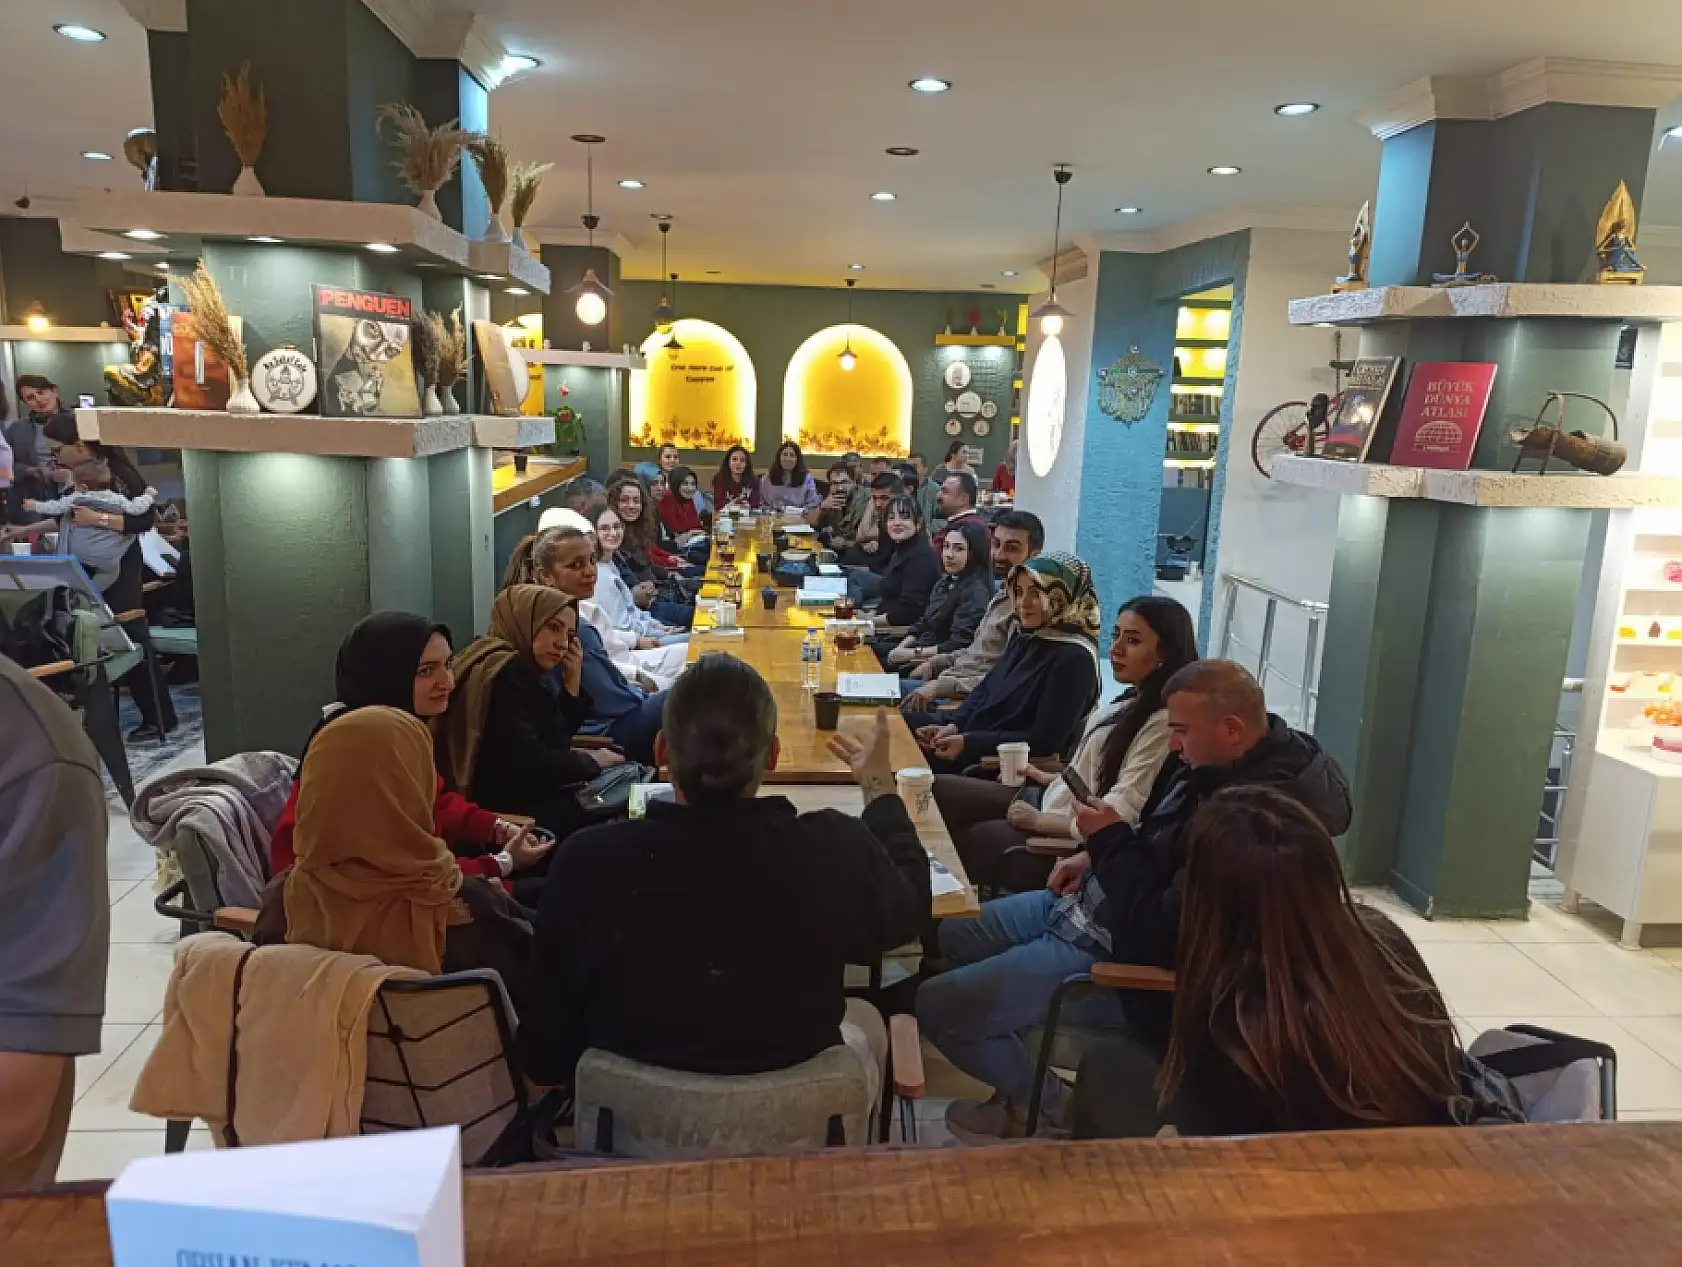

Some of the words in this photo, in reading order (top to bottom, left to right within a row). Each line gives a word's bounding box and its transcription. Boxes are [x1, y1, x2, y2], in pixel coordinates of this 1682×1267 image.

[319, 288, 411, 317] PENGUEN
[1426, 378, 1474, 393] BÜYÜK
[1424, 392, 1470, 405] DÜNYA
